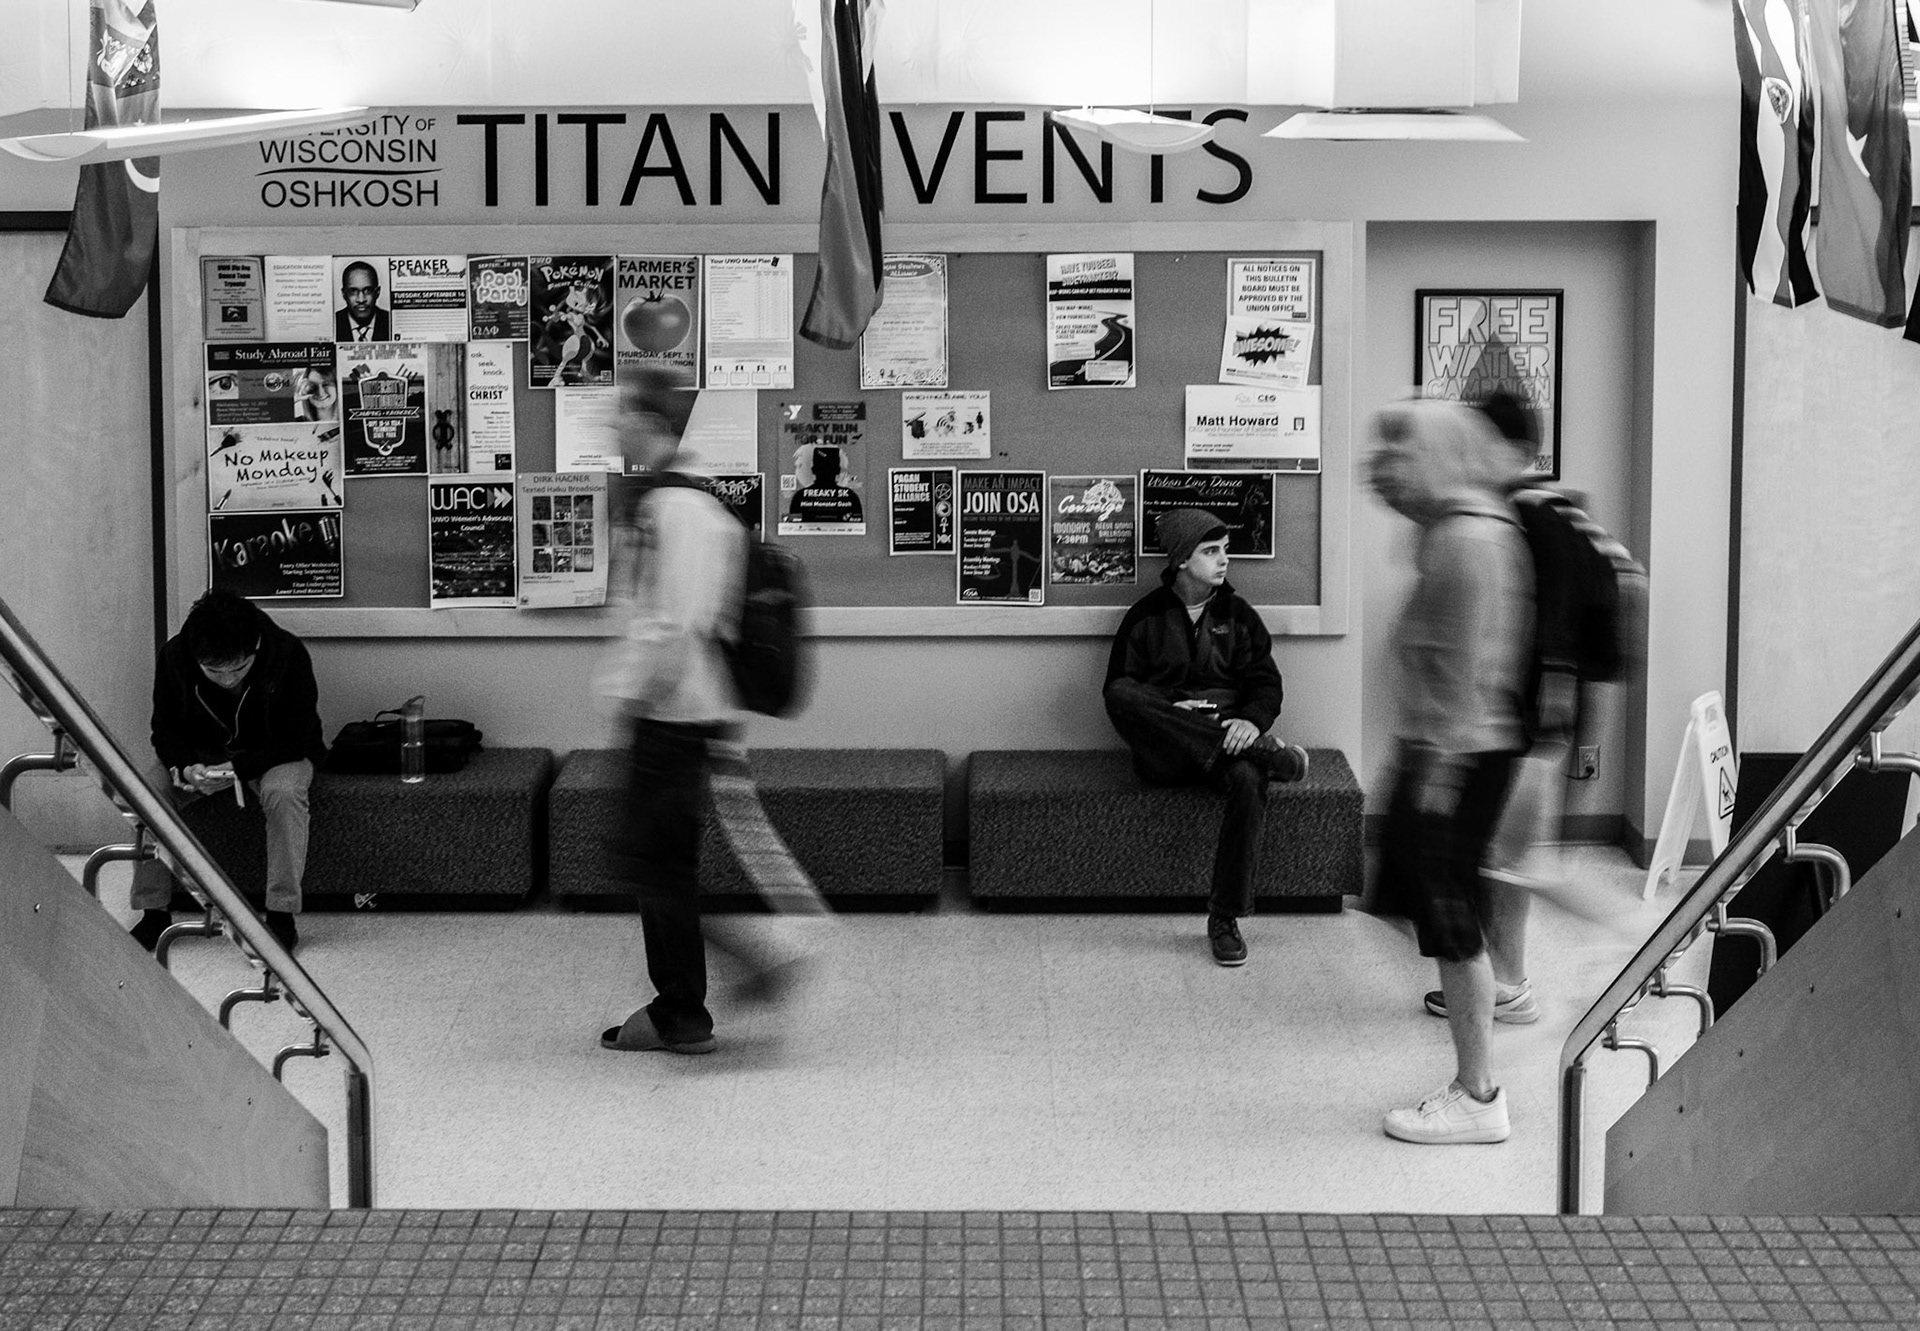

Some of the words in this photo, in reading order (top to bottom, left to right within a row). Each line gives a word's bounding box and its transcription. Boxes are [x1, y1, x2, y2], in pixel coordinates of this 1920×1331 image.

[415, 118, 436, 131] OF
[259, 138, 437, 164] WISCONSIN
[457, 112, 781, 207] TITAN
[888, 109, 1252, 205] VENTS
[261, 179, 439, 208] OSHKOSH
[389, 258, 448, 270] SPEAKER
[618, 260, 695, 274] FARMER'S
[1242, 264, 1256, 273] ALL
[1256, 264, 1288, 273] NOTICES
[1289, 264, 1301, 272] ON
[481, 268, 522, 288] Pool
[618, 275, 695, 290] MARKET
[1245, 274, 1262, 282] THIS
[1263, 274, 1298, 282] BULLETIN
[1242, 284, 1267, 293] BOARD
[1268, 284, 1289, 293] MUST
[1291, 284, 1301, 293] BE
[476, 285, 528, 306] Party
[1238, 294, 1277, 302] APPROVED
[1278, 294, 1289, 302] BY
[1290, 294, 1304, 302] THE
[1246, 304, 1270, 312] UNION
[1272, 304, 1296, 312] OFFICE
[1428, 297, 1550, 344] FREE
[1232, 336, 1302, 356] AWESOME!
[235, 349, 266, 362] Study
[268, 348, 308, 360] Abroad
[310, 346, 332, 358] Fair
[617, 351, 661, 360] THURSDAY,
[662, 351, 684, 360] SEPT.
[686, 351, 694, 360] 11
[668, 359, 694, 368] UNION
[1428, 345, 1551, 379] WATER
[469, 384, 509, 392] discovering
[470, 390, 504, 400] CHRIST
[1197, 415, 1225, 427] Matt
[1229, 414, 1279, 427] Howard
[784, 422, 829, 434] FREAKY
[832, 422, 858, 434] RUN
[795, 434, 818, 445] FOR
[823, 434, 848, 445] FUN
[224, 452, 254, 468] No
[259, 448, 329, 468] Makeup
[236, 461, 317, 484] Monday
[534, 476, 554, 484] DIRK
[893, 474, 920, 484] PAGAN
[964, 478, 990, 490] MAKE
[992, 478, 1005, 489] AN
[1008, 477, 1041, 488] IMPACT
[1147, 475, 1182, 488] Urban
[1210, 474, 1243, 488] Dance
[568, 484, 606, 493] Broadsides
[803, 488, 836, 498] FREAKY
[837, 488, 850, 498] 5K
[893, 482, 930, 493] STUDENT
[431, 486, 486, 511] WAC
[893, 492, 930, 503] ALLIANCE
[963, 492, 1002, 514] JOIN
[1006, 492, 1040, 514] OSA
[814, 500, 837, 508] Monster
[1058, 494, 1124, 522] Converge
[482, 514, 513, 523] Advocacy
[460, 524, 486, 532] Council
[1053, 522, 1092, 534] MONDAYS
[1098, 530, 1132, 538] BALLROOM
[213, 518, 313, 567] Karaoke
[1056, 534, 1089, 544] 7:30PM
[275, 588, 292, 596] Lower
